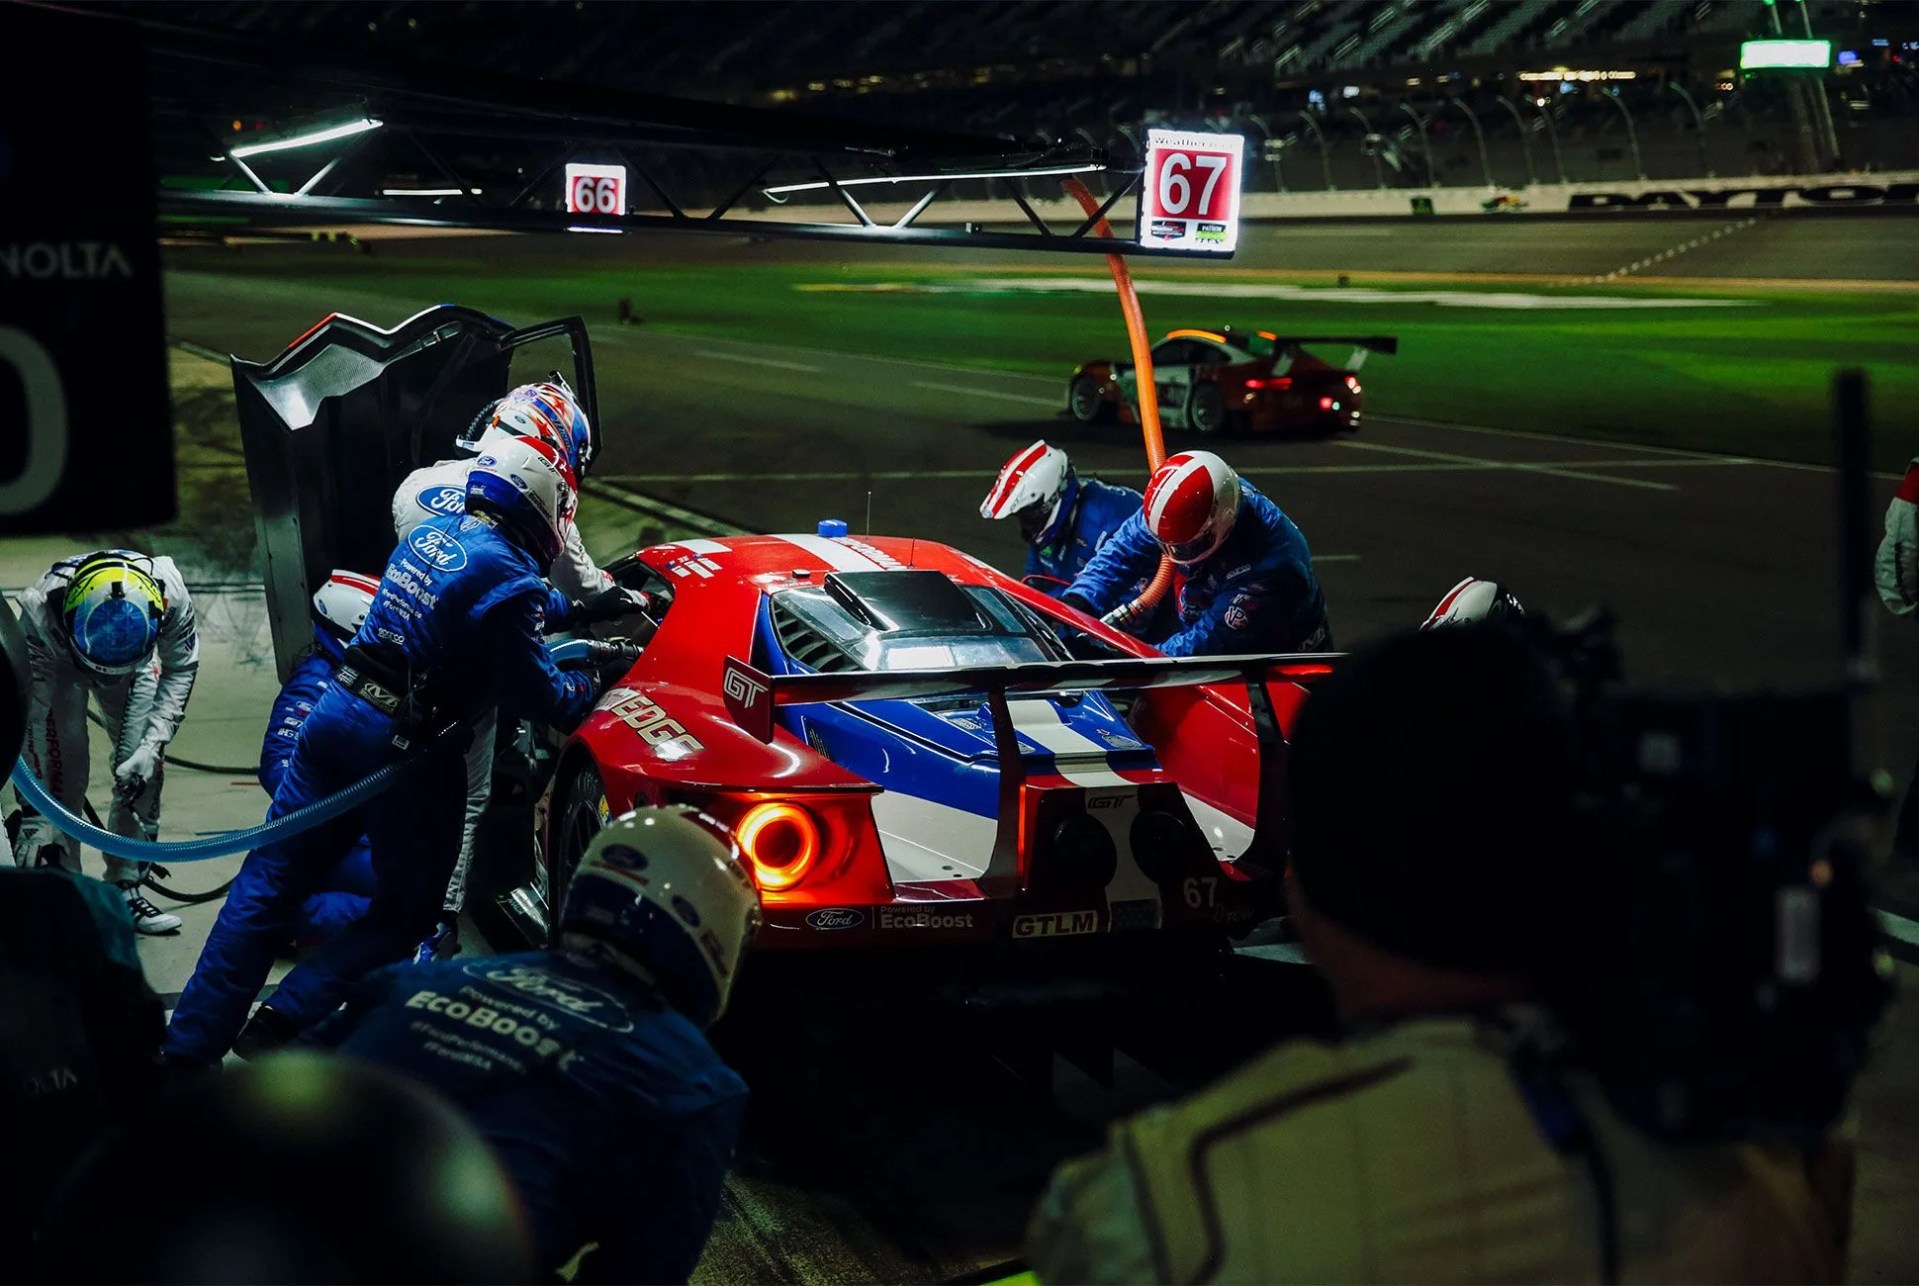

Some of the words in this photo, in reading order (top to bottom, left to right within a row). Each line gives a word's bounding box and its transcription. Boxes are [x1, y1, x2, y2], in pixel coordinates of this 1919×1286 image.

[574, 176, 616, 214] 66
[1159, 152, 1228, 216] 67
[723, 666, 769, 709] GT
[1182, 876, 1219, 909] 67
[816, 911, 853, 927] Ford
[880, 913, 974, 929] EcoBoost
[1014, 912, 1095, 936] GTLM
